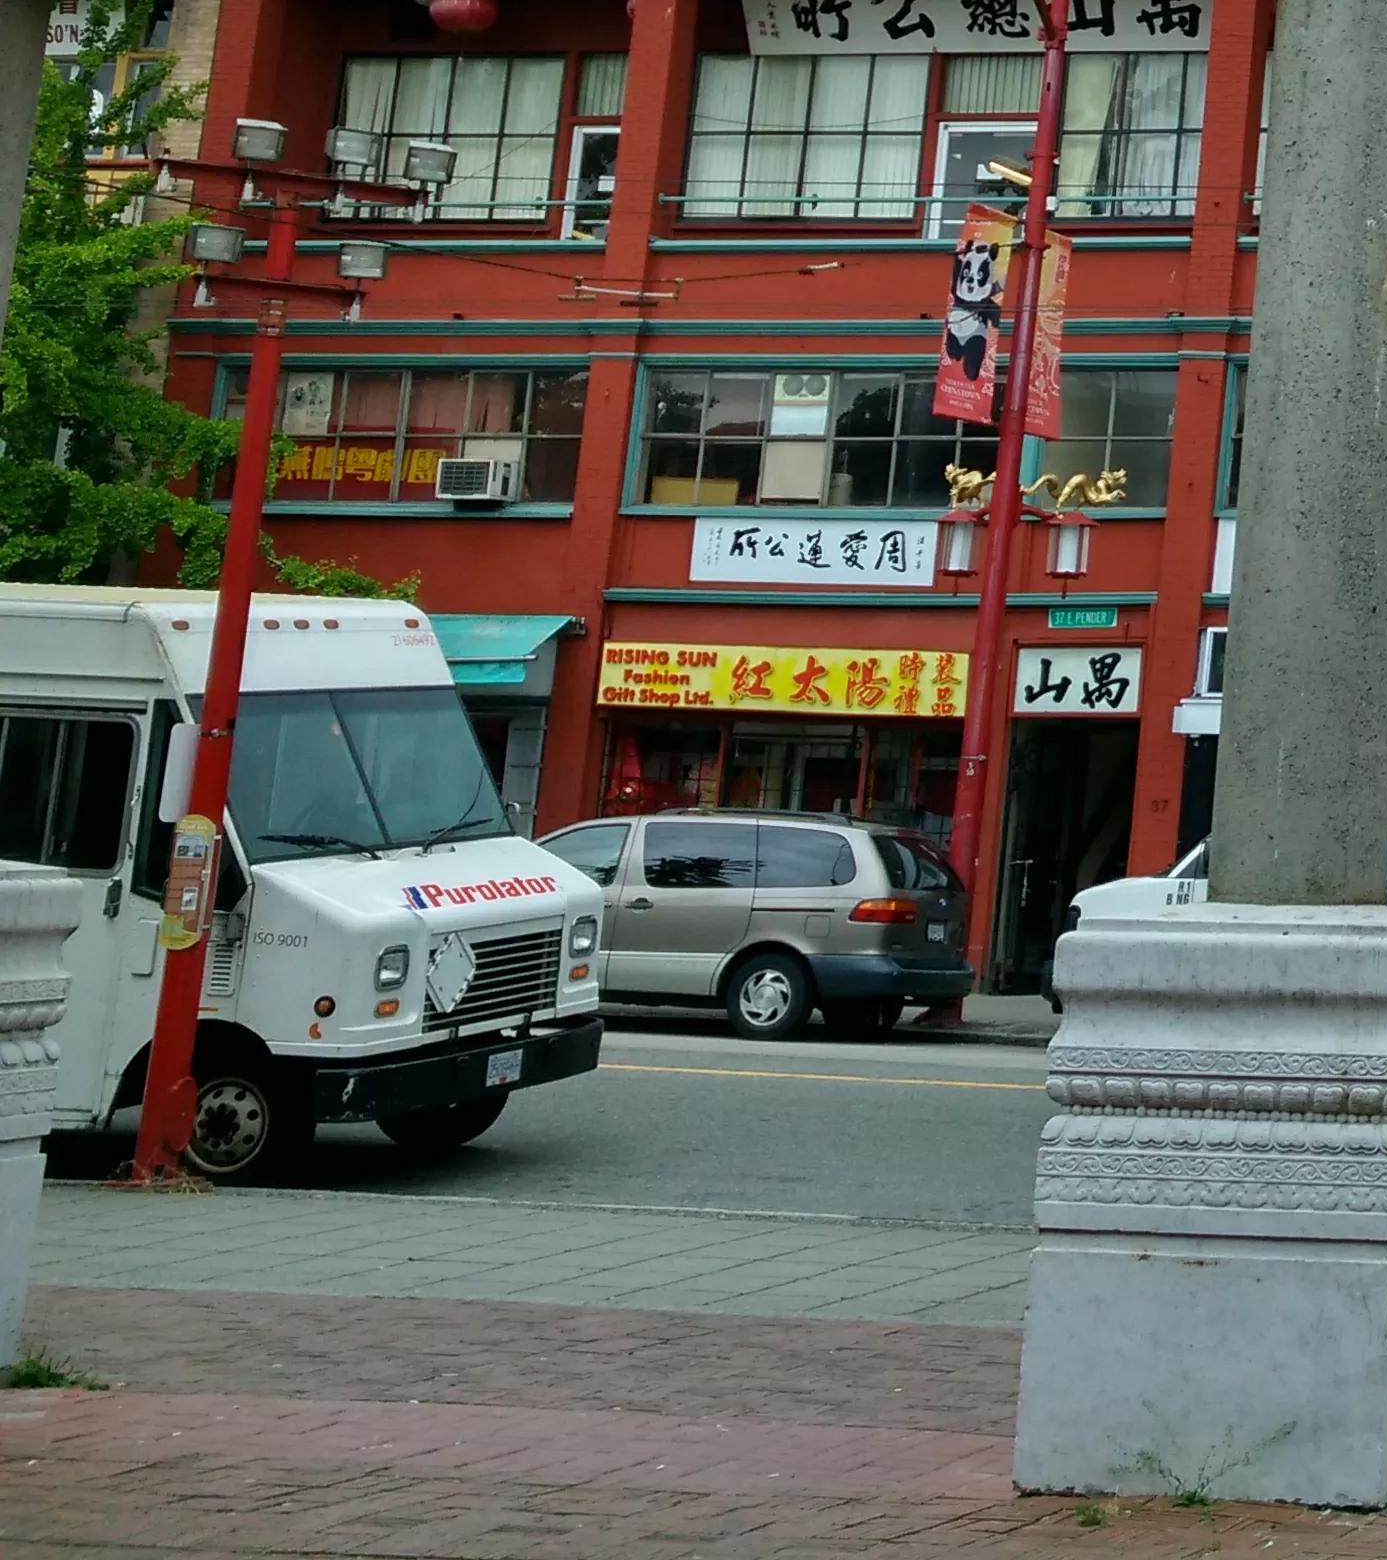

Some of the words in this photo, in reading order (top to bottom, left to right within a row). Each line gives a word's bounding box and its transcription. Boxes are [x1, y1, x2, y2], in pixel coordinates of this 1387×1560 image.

[1075, 611, 1108, 624] PENDER
[606, 648, 670, 665] RISING
[676, 650, 718, 667] SUN
[623, 669, 690, 686] Fashion
[728, 654, 890, 710] 紅太陽
[602, 686, 636, 703] Gift
[639, 688, 681, 707] Shop
[684, 690, 714, 706] Ltd.
[420, 876, 557, 908] Purolator
[253, 931, 275, 946] ISO
[276, 931, 309, 948] 9001
